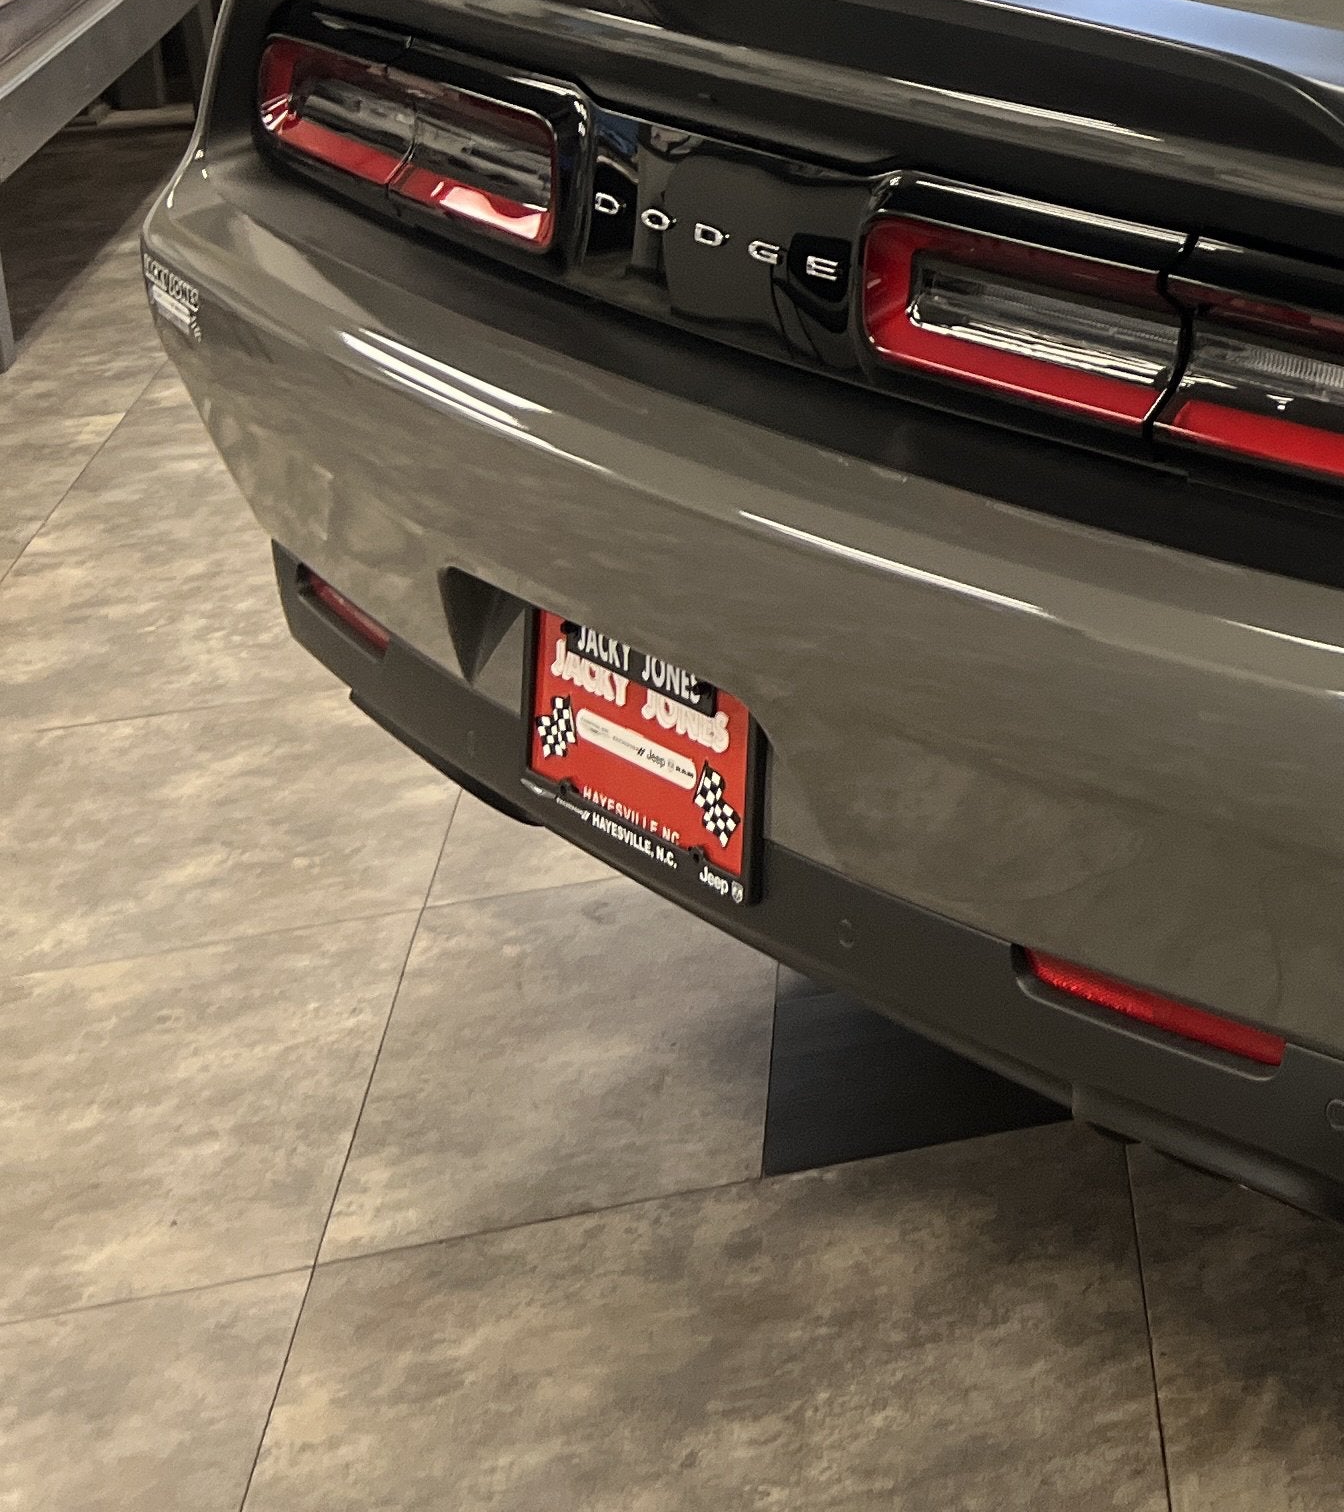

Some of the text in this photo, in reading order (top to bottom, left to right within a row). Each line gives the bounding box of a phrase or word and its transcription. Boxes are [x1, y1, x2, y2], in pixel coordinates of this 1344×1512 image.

[594, 191, 839, 281] DODGE
[577, 624, 631, 672] JACKY
[551, 638, 730, 754] JACKY JONES
[699, 865, 729, 897] Jeep
